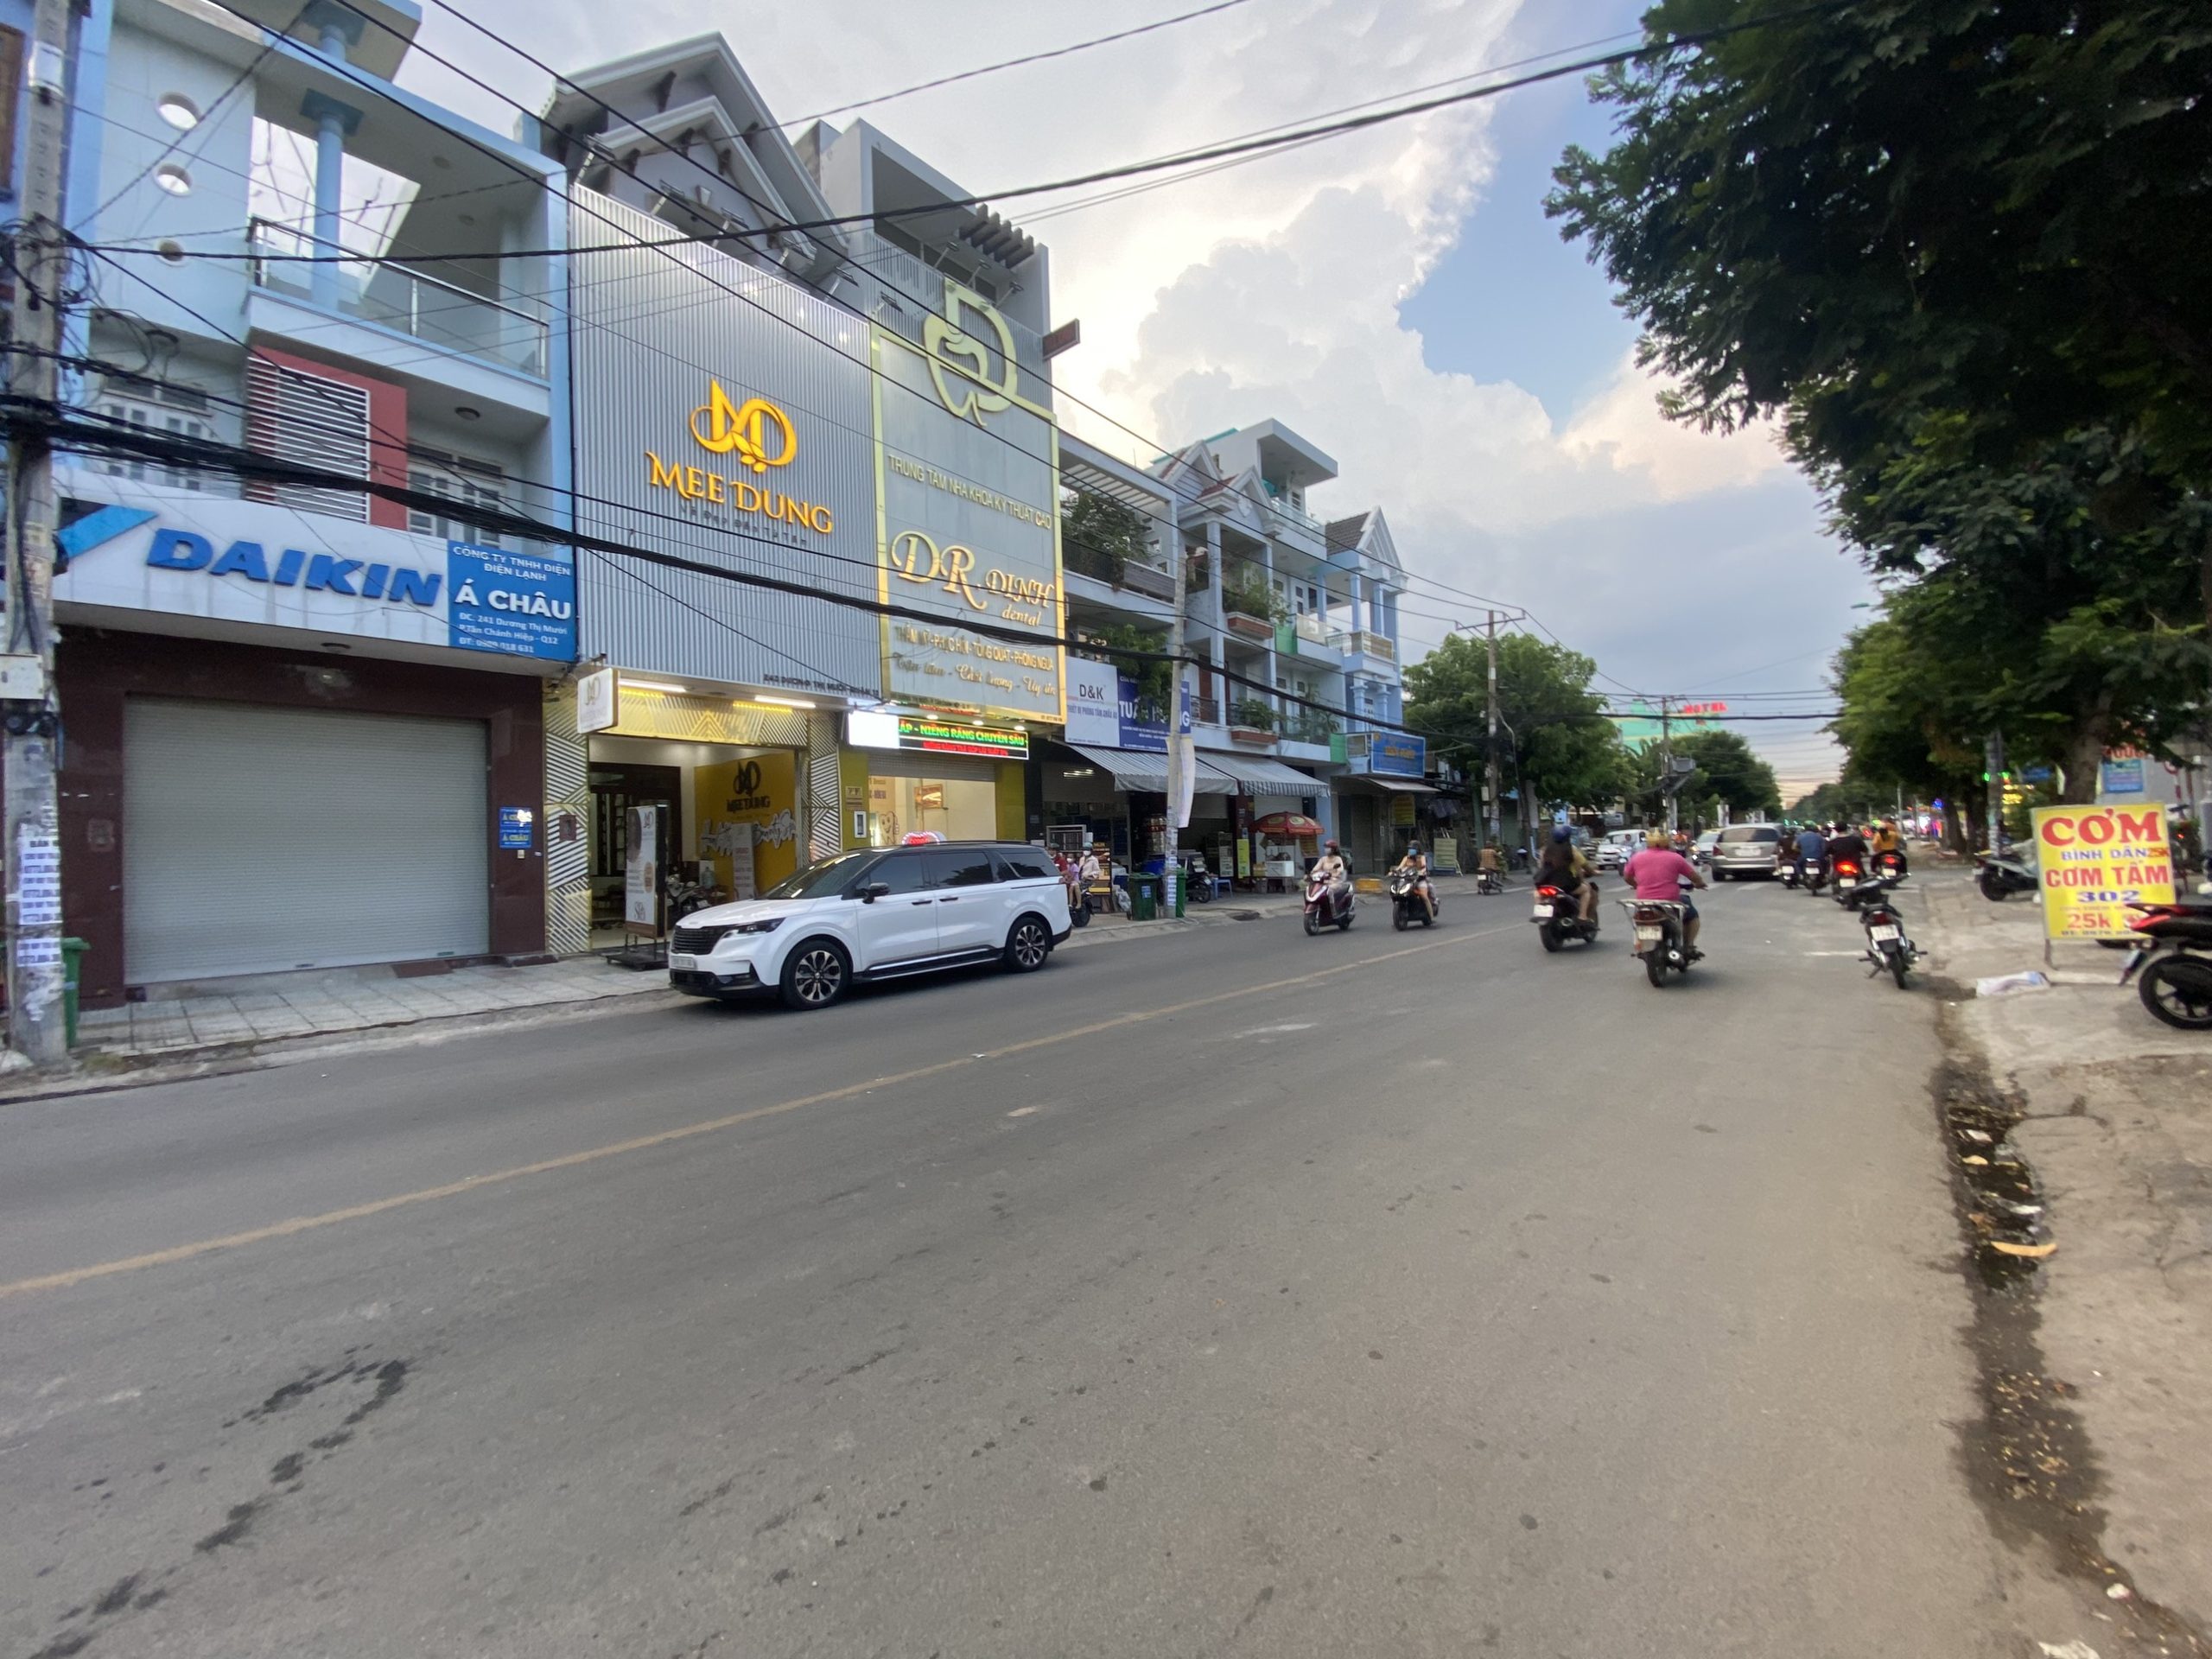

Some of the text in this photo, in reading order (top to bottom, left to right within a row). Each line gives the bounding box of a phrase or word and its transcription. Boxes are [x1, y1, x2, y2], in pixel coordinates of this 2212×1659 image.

[645, 450, 834, 533] MEE DUNG
[888, 454, 925, 482] TRUNG
[926, 469, 946, 490] TÂM
[950, 478, 968, 498] NHA
[969, 487, 994, 507] KHOA
[1036, 512, 1052, 529] CAO
[146, 526, 442, 607] DAIKIN
[453, 546, 570, 575] CÔNG TY TNHH ĐIỆN
[484, 563, 547, 582] ĐIỆN LẠNH
[454, 578, 570, 620] Á CHÂU
[478, 615, 493, 625] 241
[496, 618, 526, 630] Dương
[529, 622, 541, 632] Thị
[1001, 605, 1042, 626] dental
[540, 635, 558, 645] Q12
[1079, 683, 1103, 700] D&K
[2042, 808, 2161, 846] CƠM
[2061, 849, 2101, 861] BÌNH
[2110, 846, 2146, 858] DÂN
[2045, 866, 2103, 887] CƠM
[2077, 890, 2140, 903] 302
